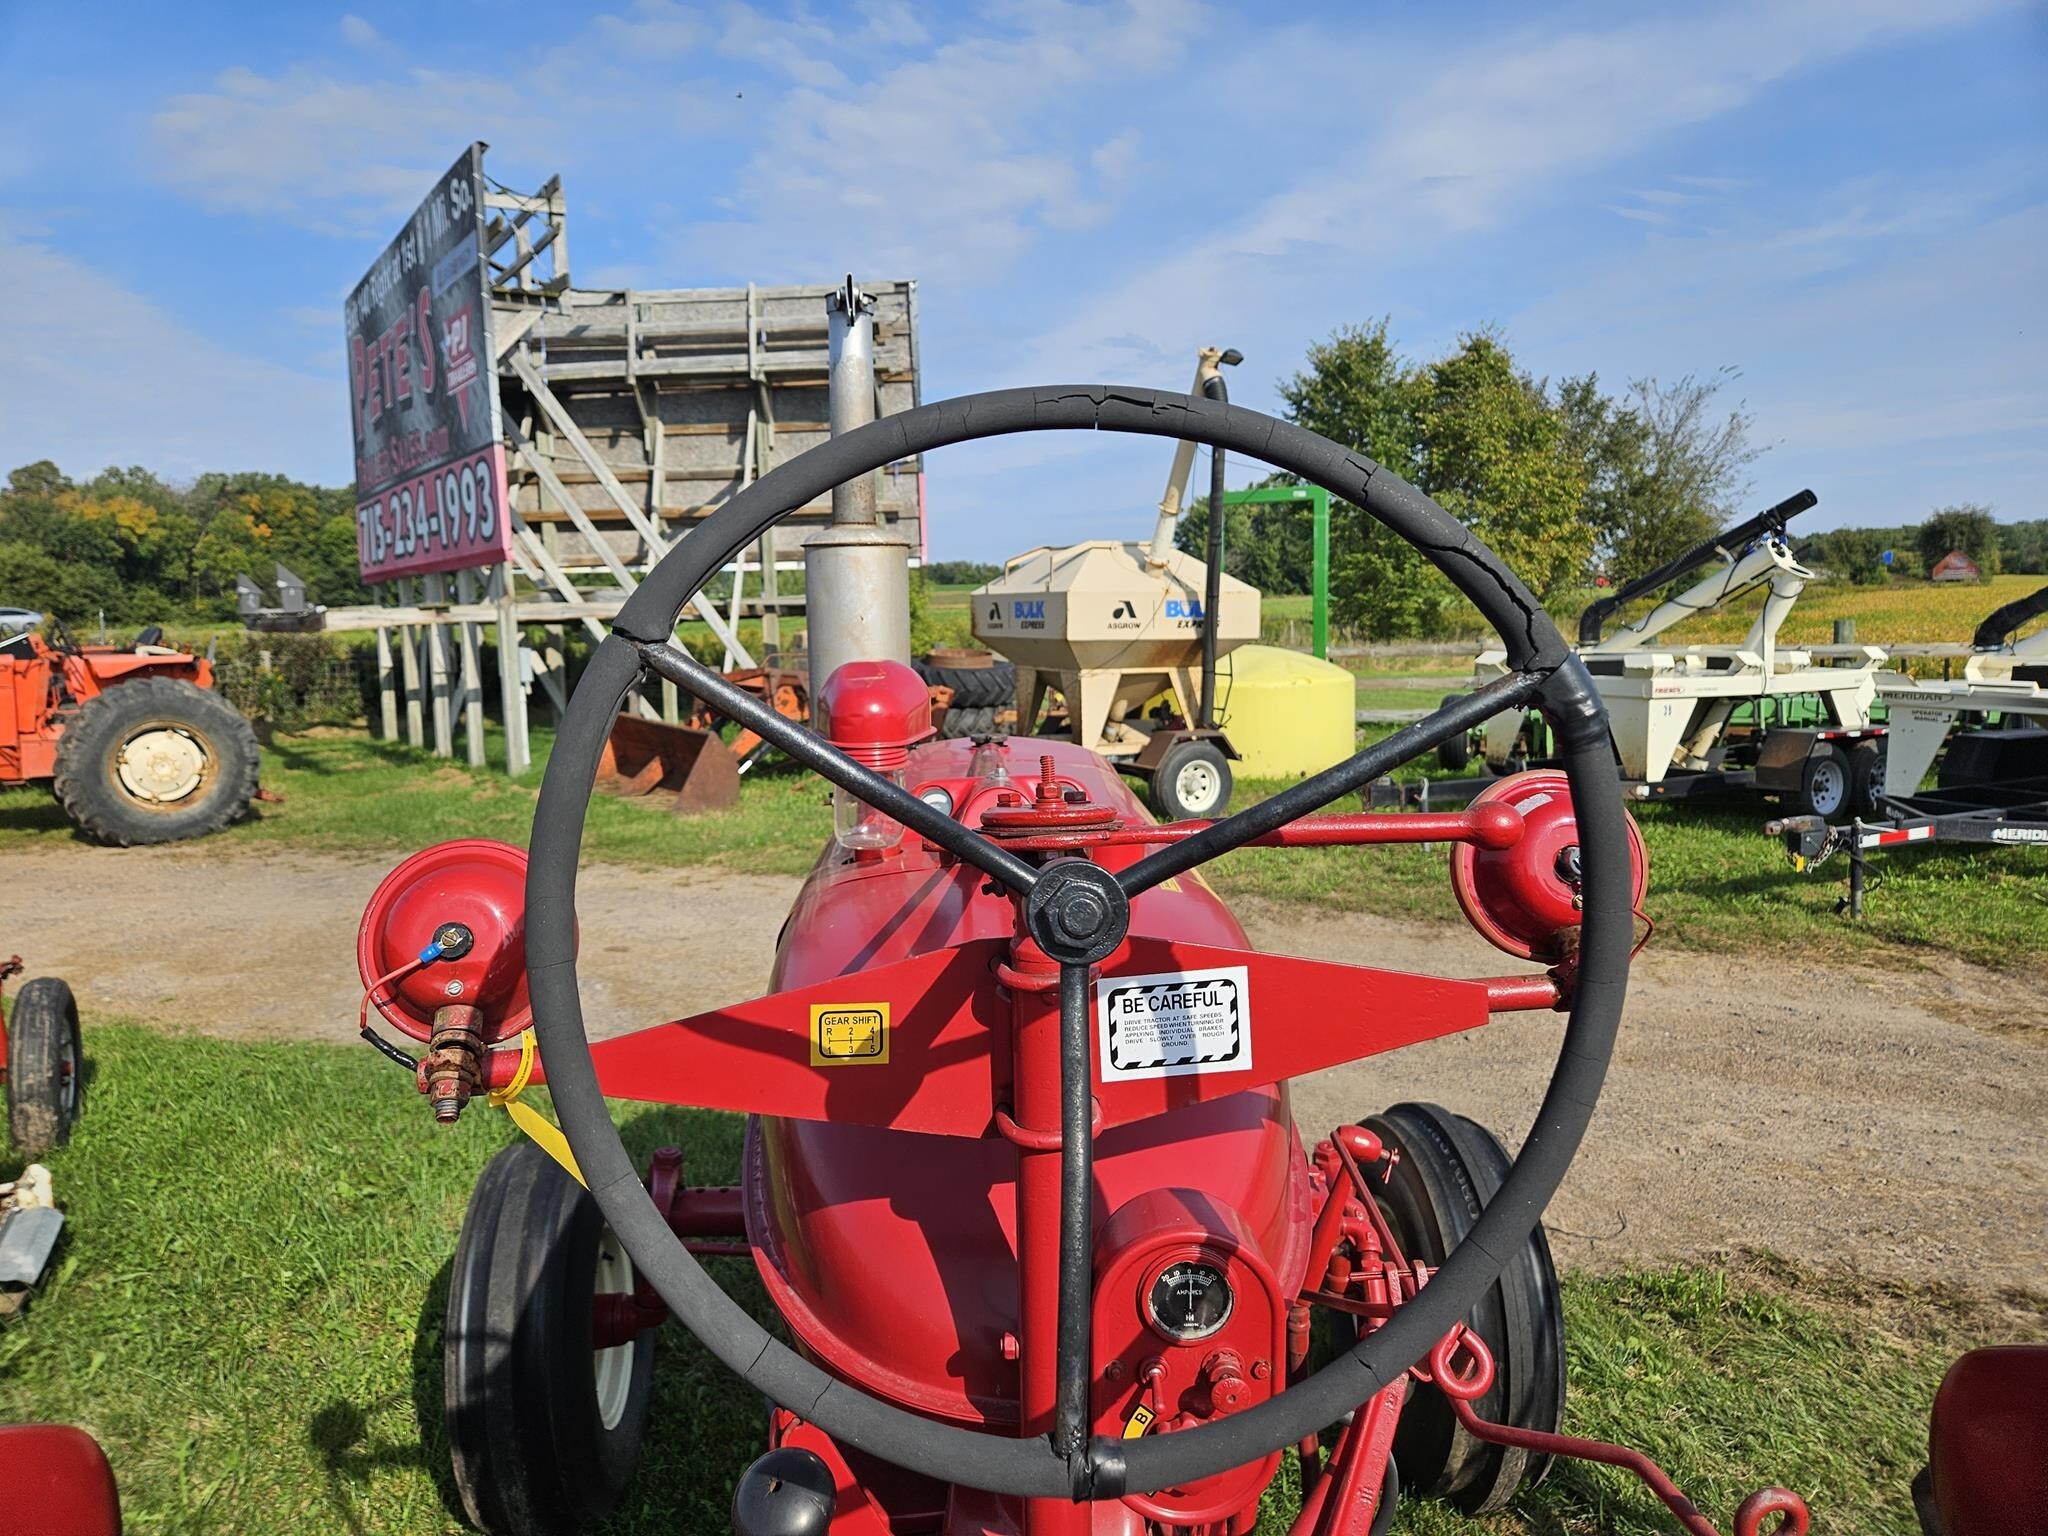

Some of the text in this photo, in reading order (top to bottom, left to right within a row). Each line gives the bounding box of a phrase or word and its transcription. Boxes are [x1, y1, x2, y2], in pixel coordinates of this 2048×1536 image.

[401, 231, 417, 273] 1st
[449, 178, 473, 220] So.
[451, 315, 468, 357] PJ
[351, 284, 435, 441] PETE'S
[360, 460, 495, 565] 715-234-1993
[1014, 600, 1044, 619] BULK
[1165, 600, 1219, 618] BUL
[1107, 621, 1141, 630] ASGROW
[1177, 620, 1220, 628] EXPRS
[1881, 692, 1942, 701] MERIDIAN
[1991, 828, 2048, 840] MERIDI
[1123, 991, 1223, 1014] BE CAREFUL
[824, 1015, 877, 1025] GEAR SHIFT
[826, 1026, 875, 1036] R 2 4
[870, 1045, 875, 1053] 5
[1161, 1274, 1169, 1282] 20
[1209, 1273, 1217, 1281] 20
[1135, 1413, 1148, 1424] B
